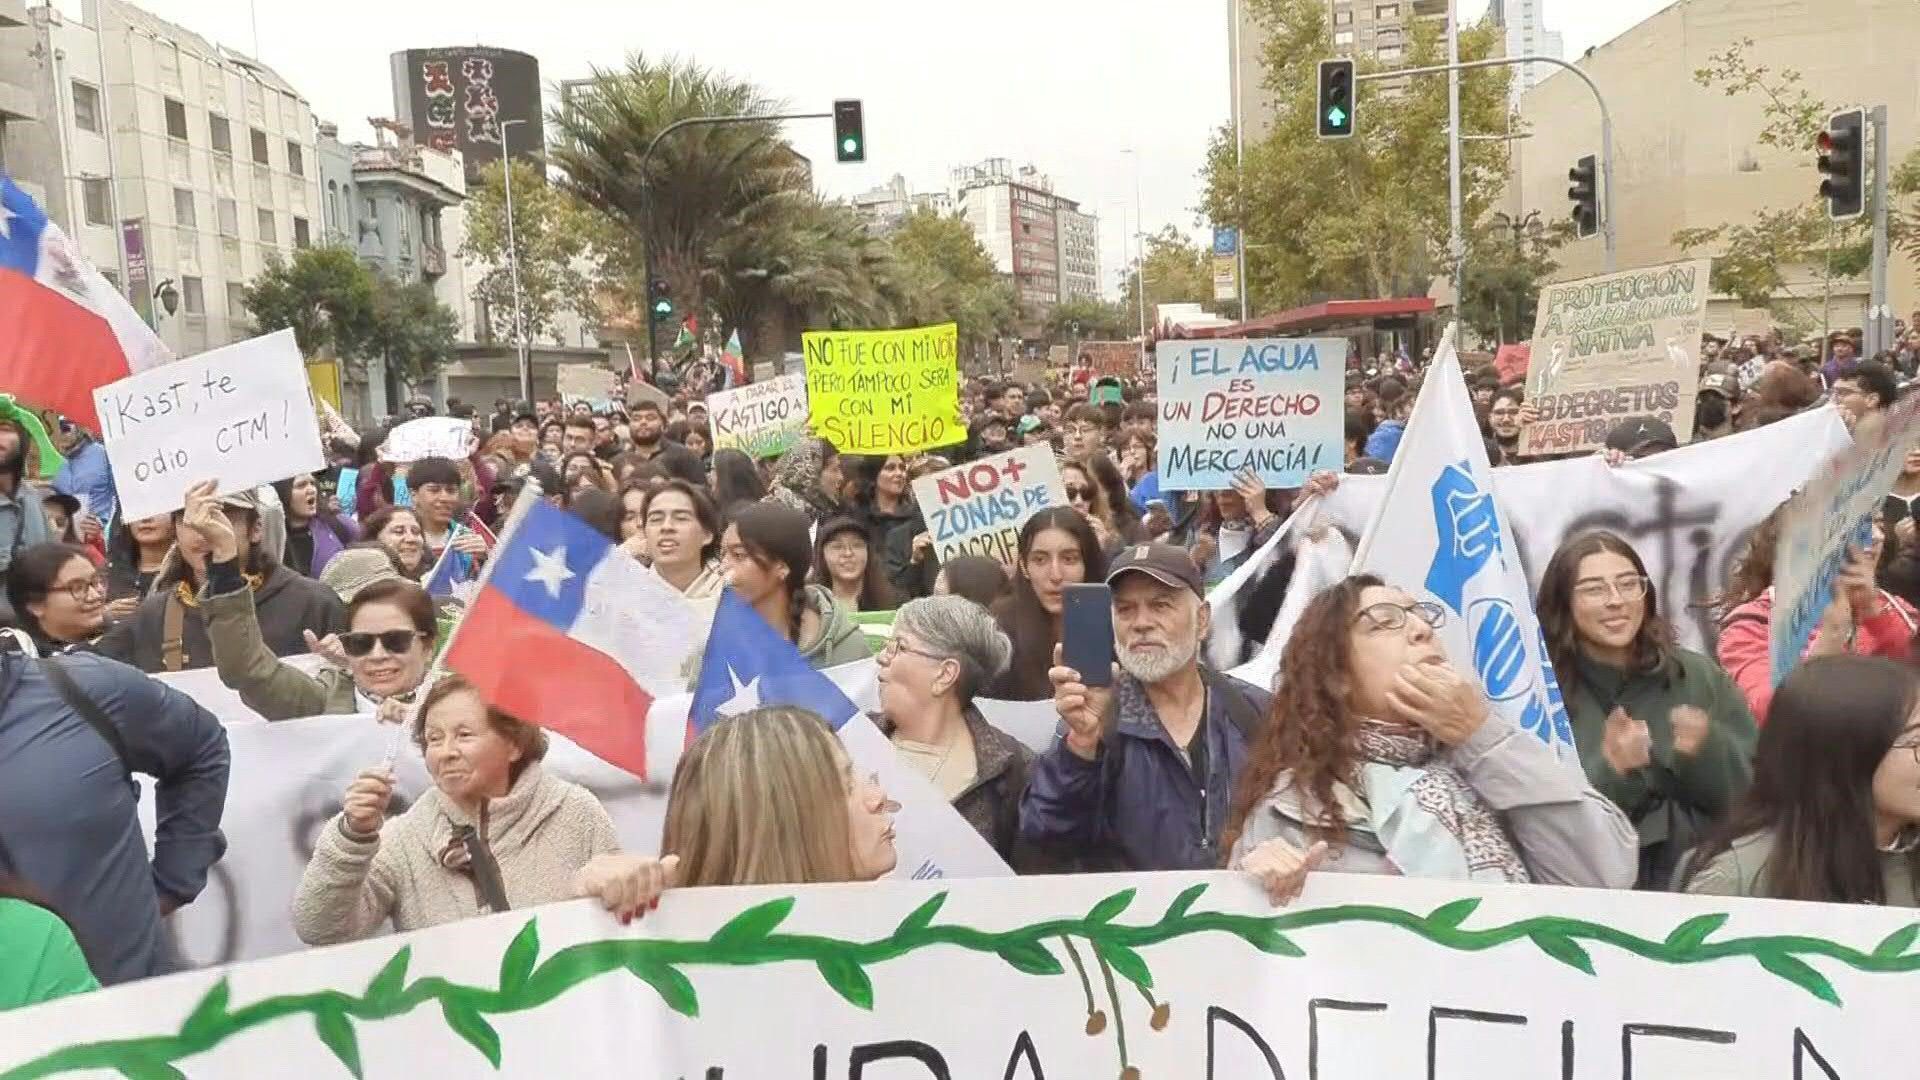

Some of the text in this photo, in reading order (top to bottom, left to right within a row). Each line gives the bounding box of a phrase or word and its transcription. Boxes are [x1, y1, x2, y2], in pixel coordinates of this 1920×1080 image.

[807, 337, 834, 366] NO
[838, 337, 867, 366] FUE
[872, 338, 906, 365] CON
[1238, 343, 1319, 373] AGUA
[203, 369, 237, 400] te
[809, 368, 846, 394] PERO
[1227, 378, 1255, 393] ES
[713, 396, 802, 436] KASTIGO A
[839, 397, 873, 418] CON
[1163, 391, 1321, 425] UN DERECHO
[1206, 421, 1286, 442] NO UNA
[135, 448, 188, 483] odio
[930, 484, 1050, 542] ZONAS DE
